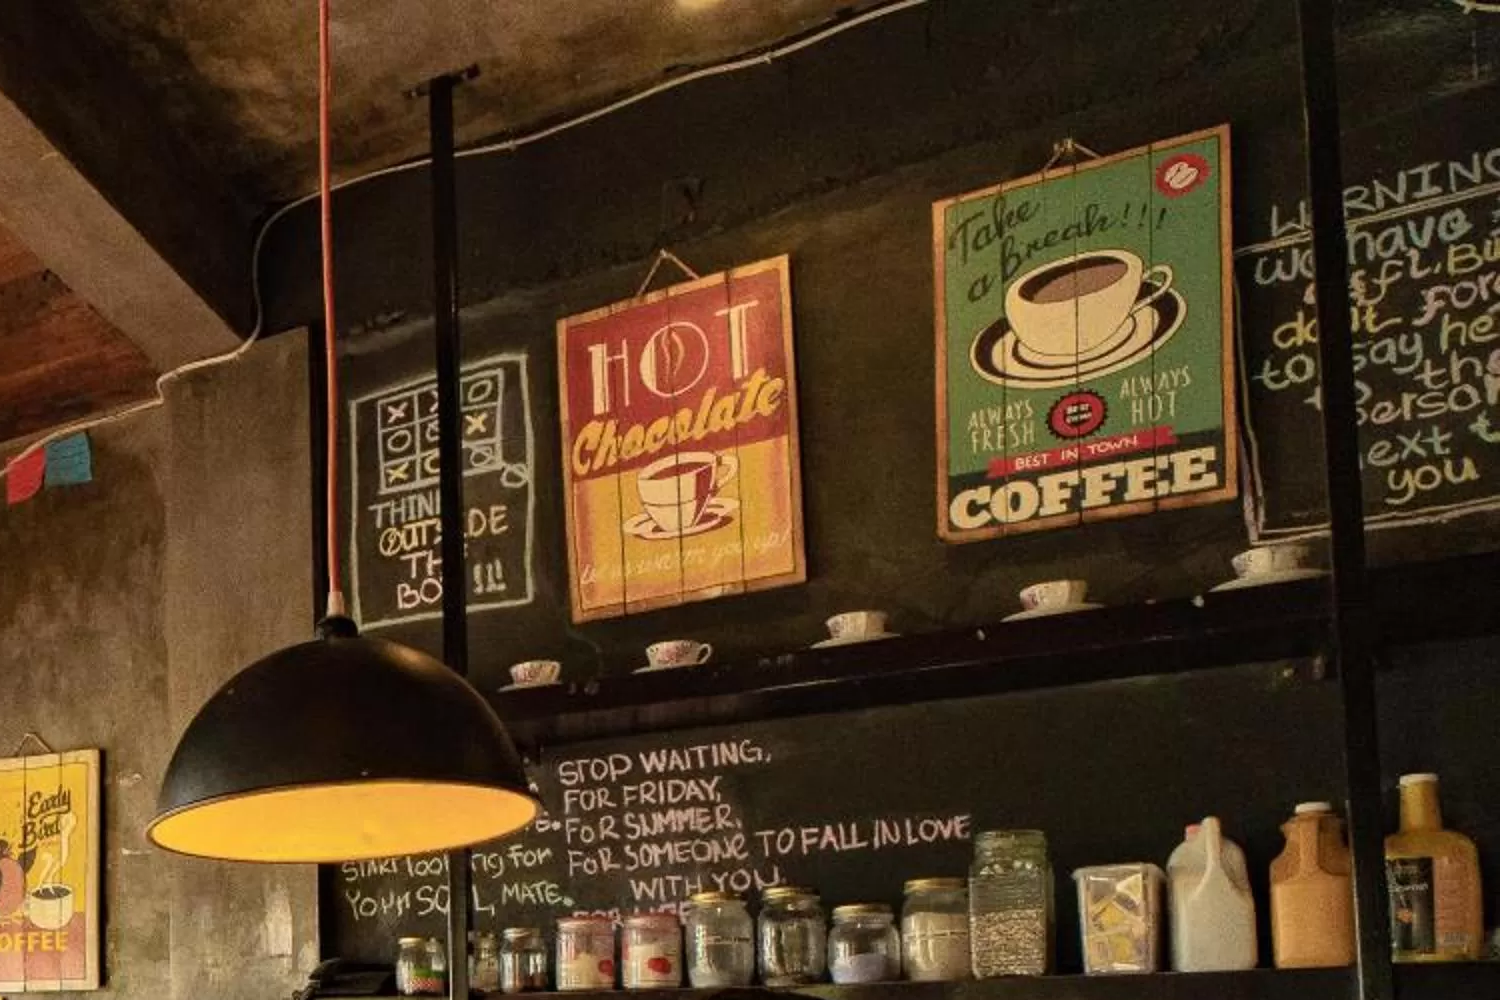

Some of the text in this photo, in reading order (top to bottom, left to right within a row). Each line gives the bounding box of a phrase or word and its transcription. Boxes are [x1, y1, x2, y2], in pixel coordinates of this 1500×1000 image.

[1271, 147, 1500, 238] WRNIN
[948, 197, 1041, 266] Take
[1346, 208, 1473, 265] have
[967, 276, 999, 304] a
[588, 300, 759, 416] HOT
[1120, 365, 1193, 399] ALWAYS
[572, 367, 787, 475] Chocolate
[967, 399, 1035, 431] ALWAYS
[1130, 392, 1178, 426] HOT
[971, 420, 1036, 454] FRESH
[1015, 434, 1140, 472] BEST IN TOWN
[1359, 424, 1453, 471] ext
[949, 445, 1218, 530] COFFEE
[1384, 456, 1481, 505] you
[369, 491, 441, 529] THIN
[558, 754, 632, 785] STOP
[27, 785, 71, 819] Early
[564, 788, 617, 814] FOR
[18, 812, 63, 849] Bird
[755, 828, 795, 857] TO
[801, 822, 869, 855] FALL
[873, 819, 901, 849] IN
[905, 814, 971, 846] LOVE
[630, 875, 702, 901] WITH
